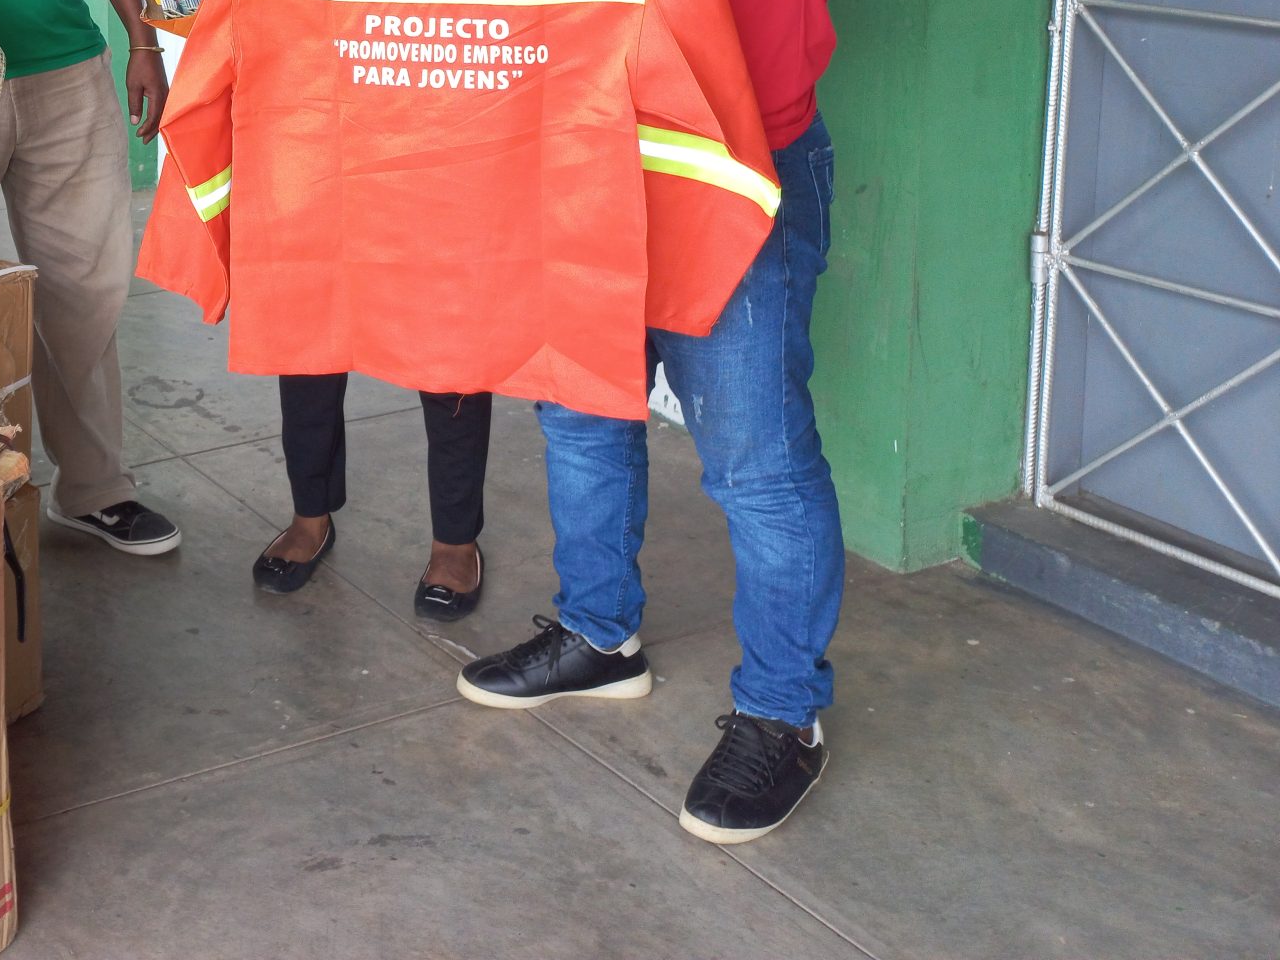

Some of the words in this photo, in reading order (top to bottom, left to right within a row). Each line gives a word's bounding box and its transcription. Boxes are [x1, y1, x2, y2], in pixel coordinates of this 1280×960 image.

[365, 14, 510, 40] PROJECTO
[334, 39, 457, 64] “PROMOVENDO
[463, 44, 549, 65] EMPREGO
[353, 65, 411, 87] PARA
[418, 69, 524, 91] JOVENS”
